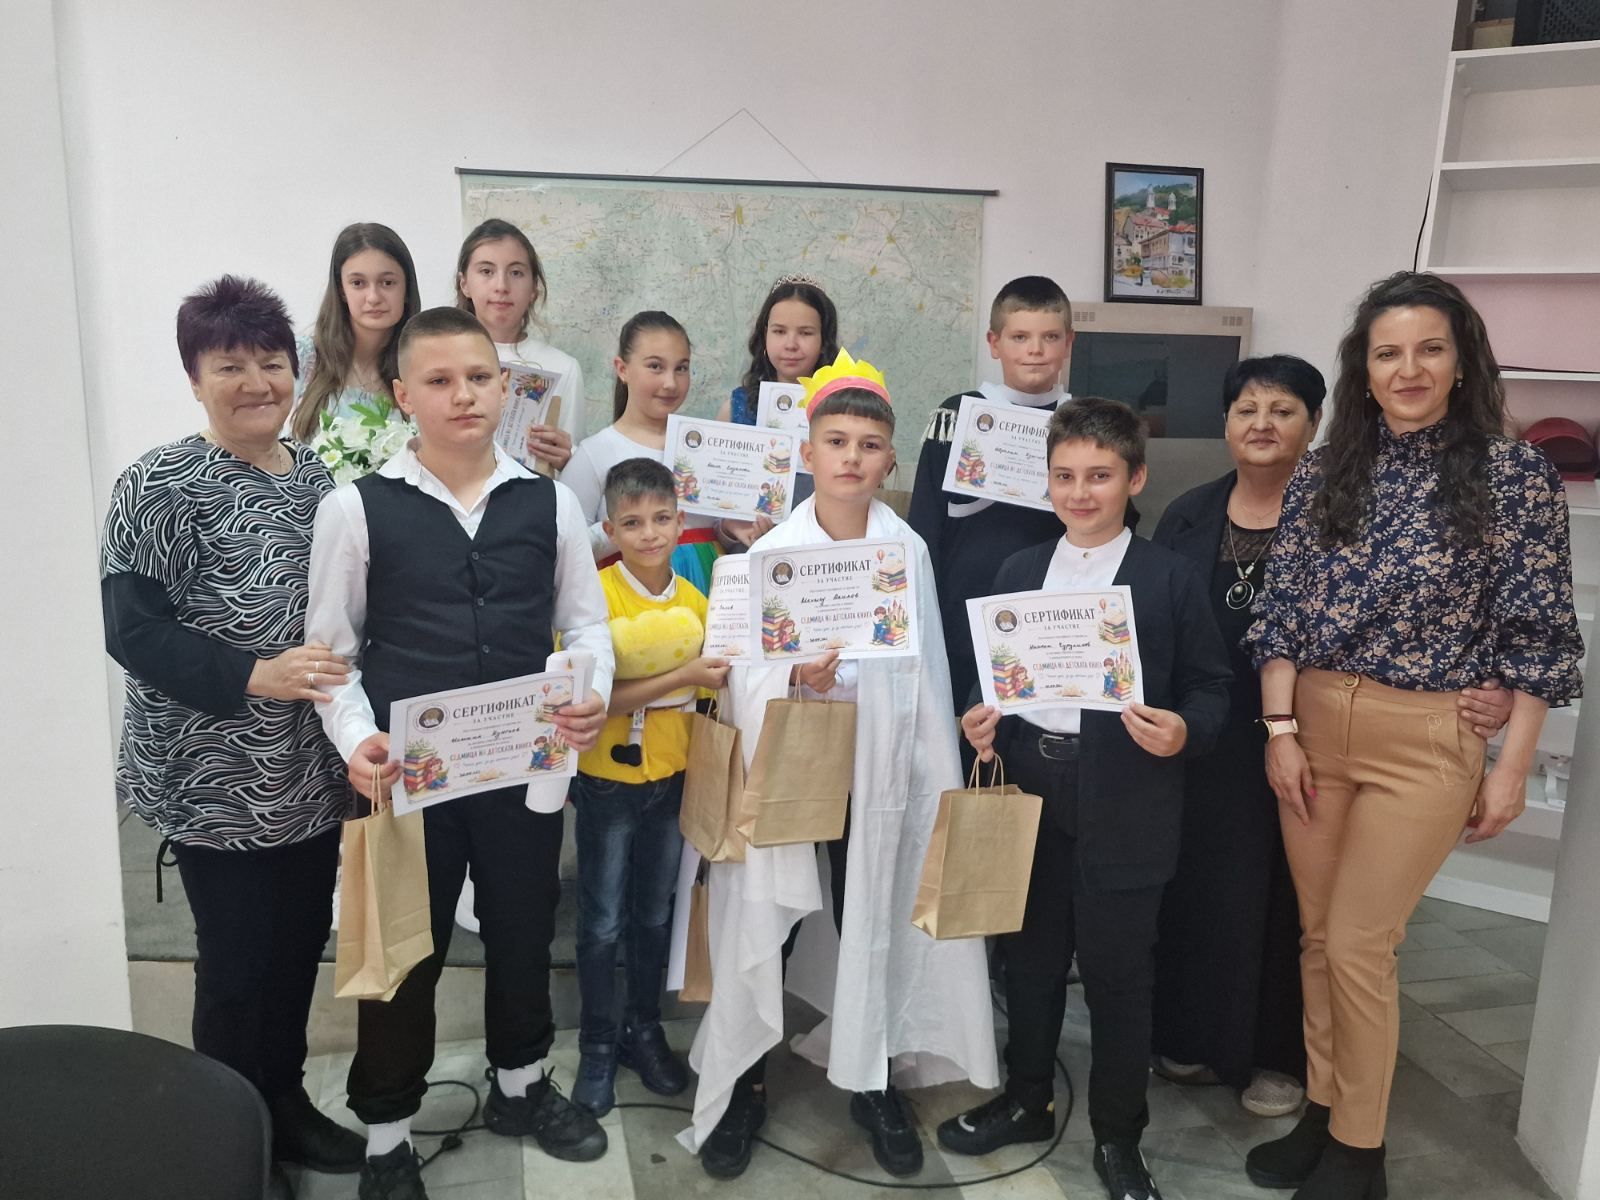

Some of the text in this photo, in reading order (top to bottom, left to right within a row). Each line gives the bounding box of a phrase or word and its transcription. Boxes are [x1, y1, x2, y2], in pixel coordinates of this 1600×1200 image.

[707, 437, 765, 453] СЕРТИФИКАТ
[799, 559, 872, 577] СЕРТИФИКАТ
[1024, 608, 1095, 624] СЕРТИФИКАТ
[453, 694, 536, 719] СЕРТИФИКАТ
